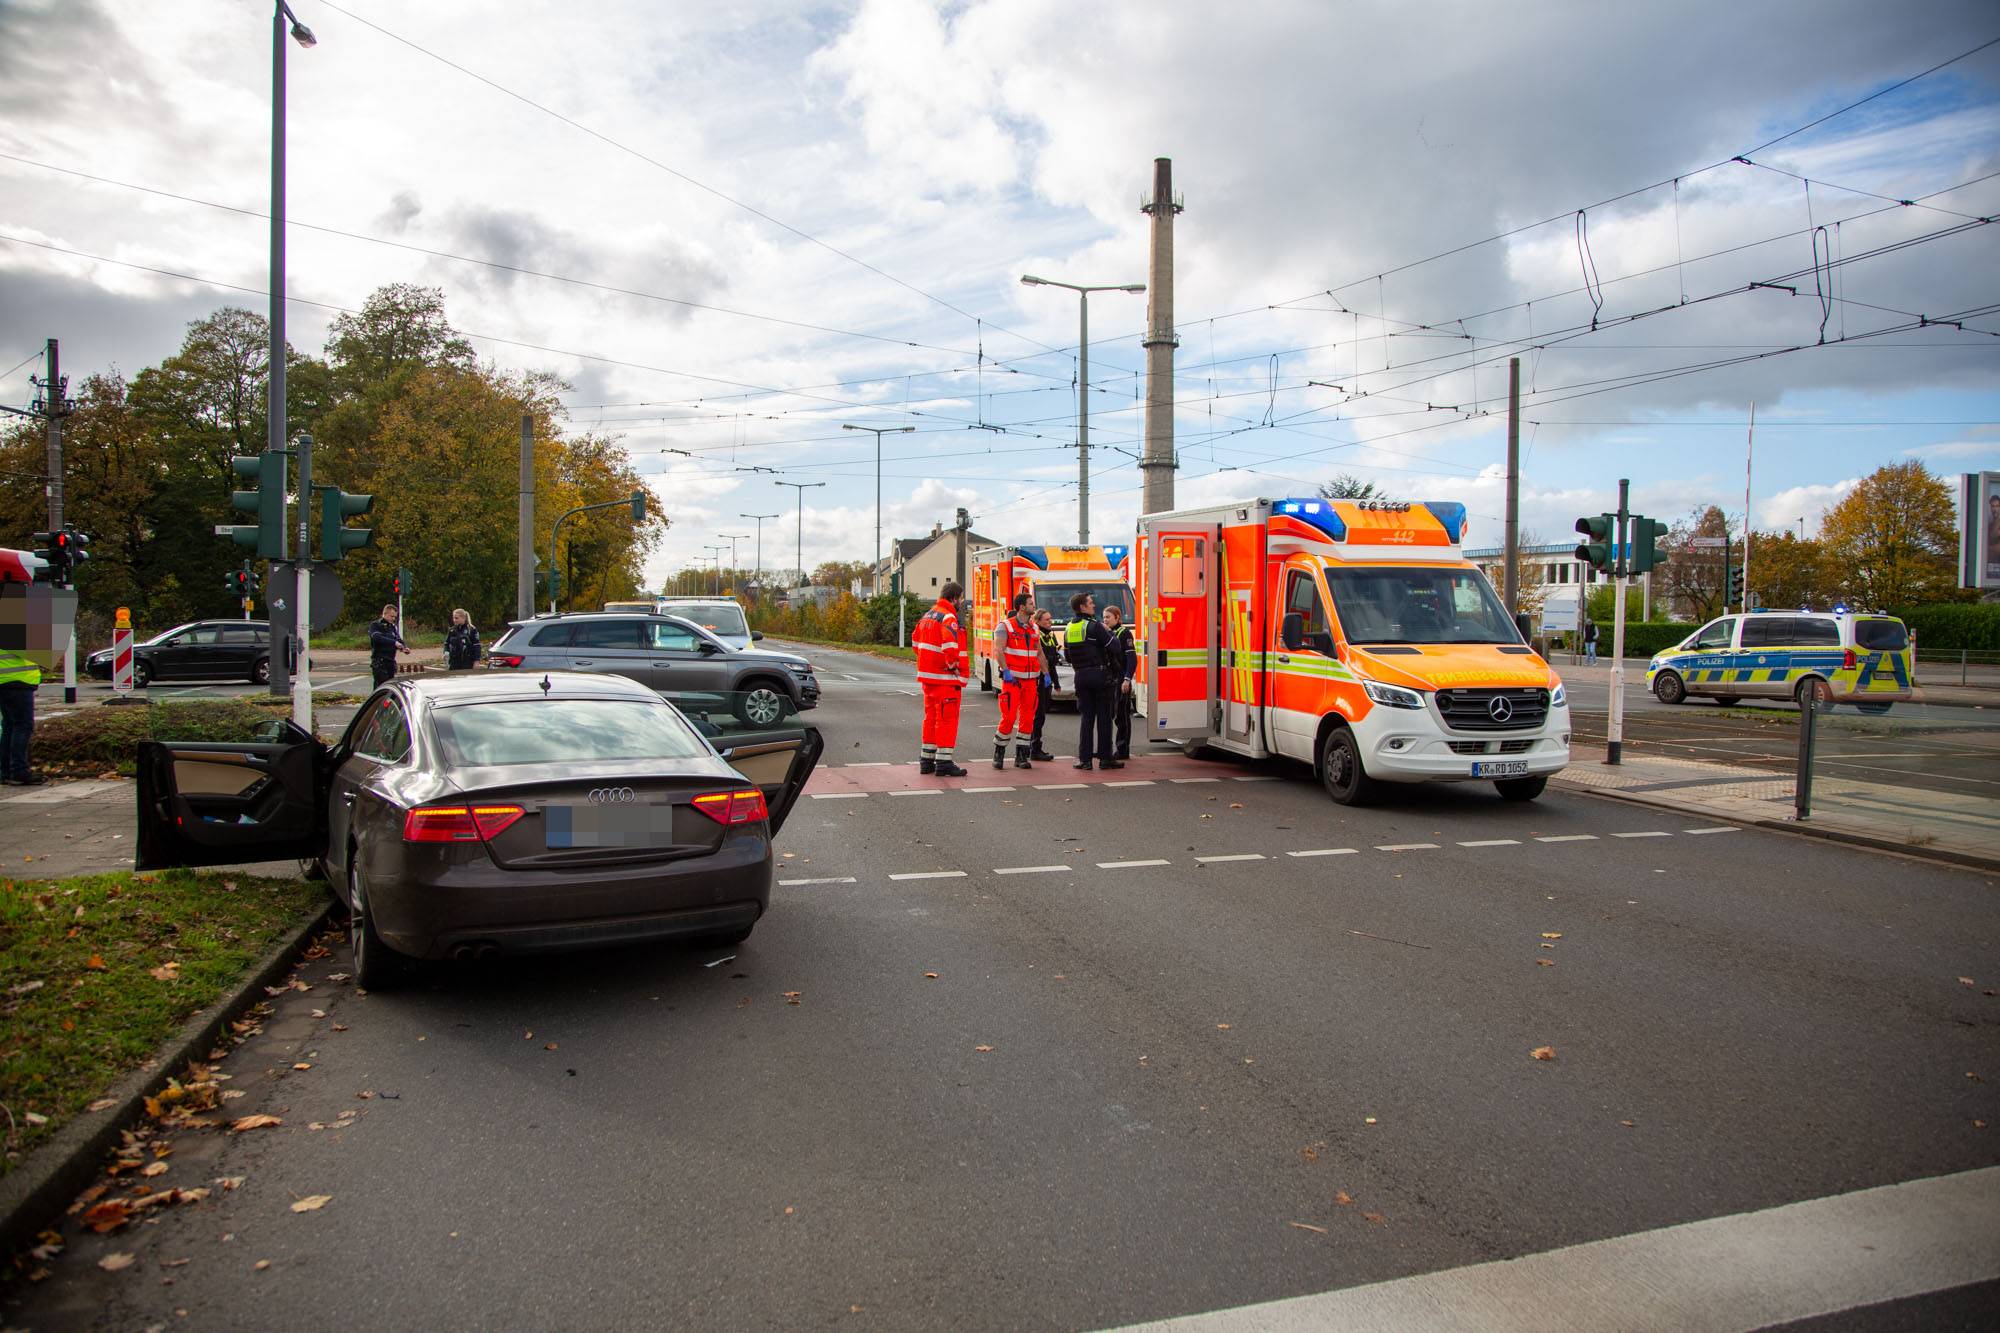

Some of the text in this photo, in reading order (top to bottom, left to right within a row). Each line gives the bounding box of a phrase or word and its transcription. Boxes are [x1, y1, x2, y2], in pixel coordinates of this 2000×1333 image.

[1393, 530, 1416, 544] 112
[1152, 607, 1176, 623] ST
[1478, 762, 1527, 775] KR RD 1052
